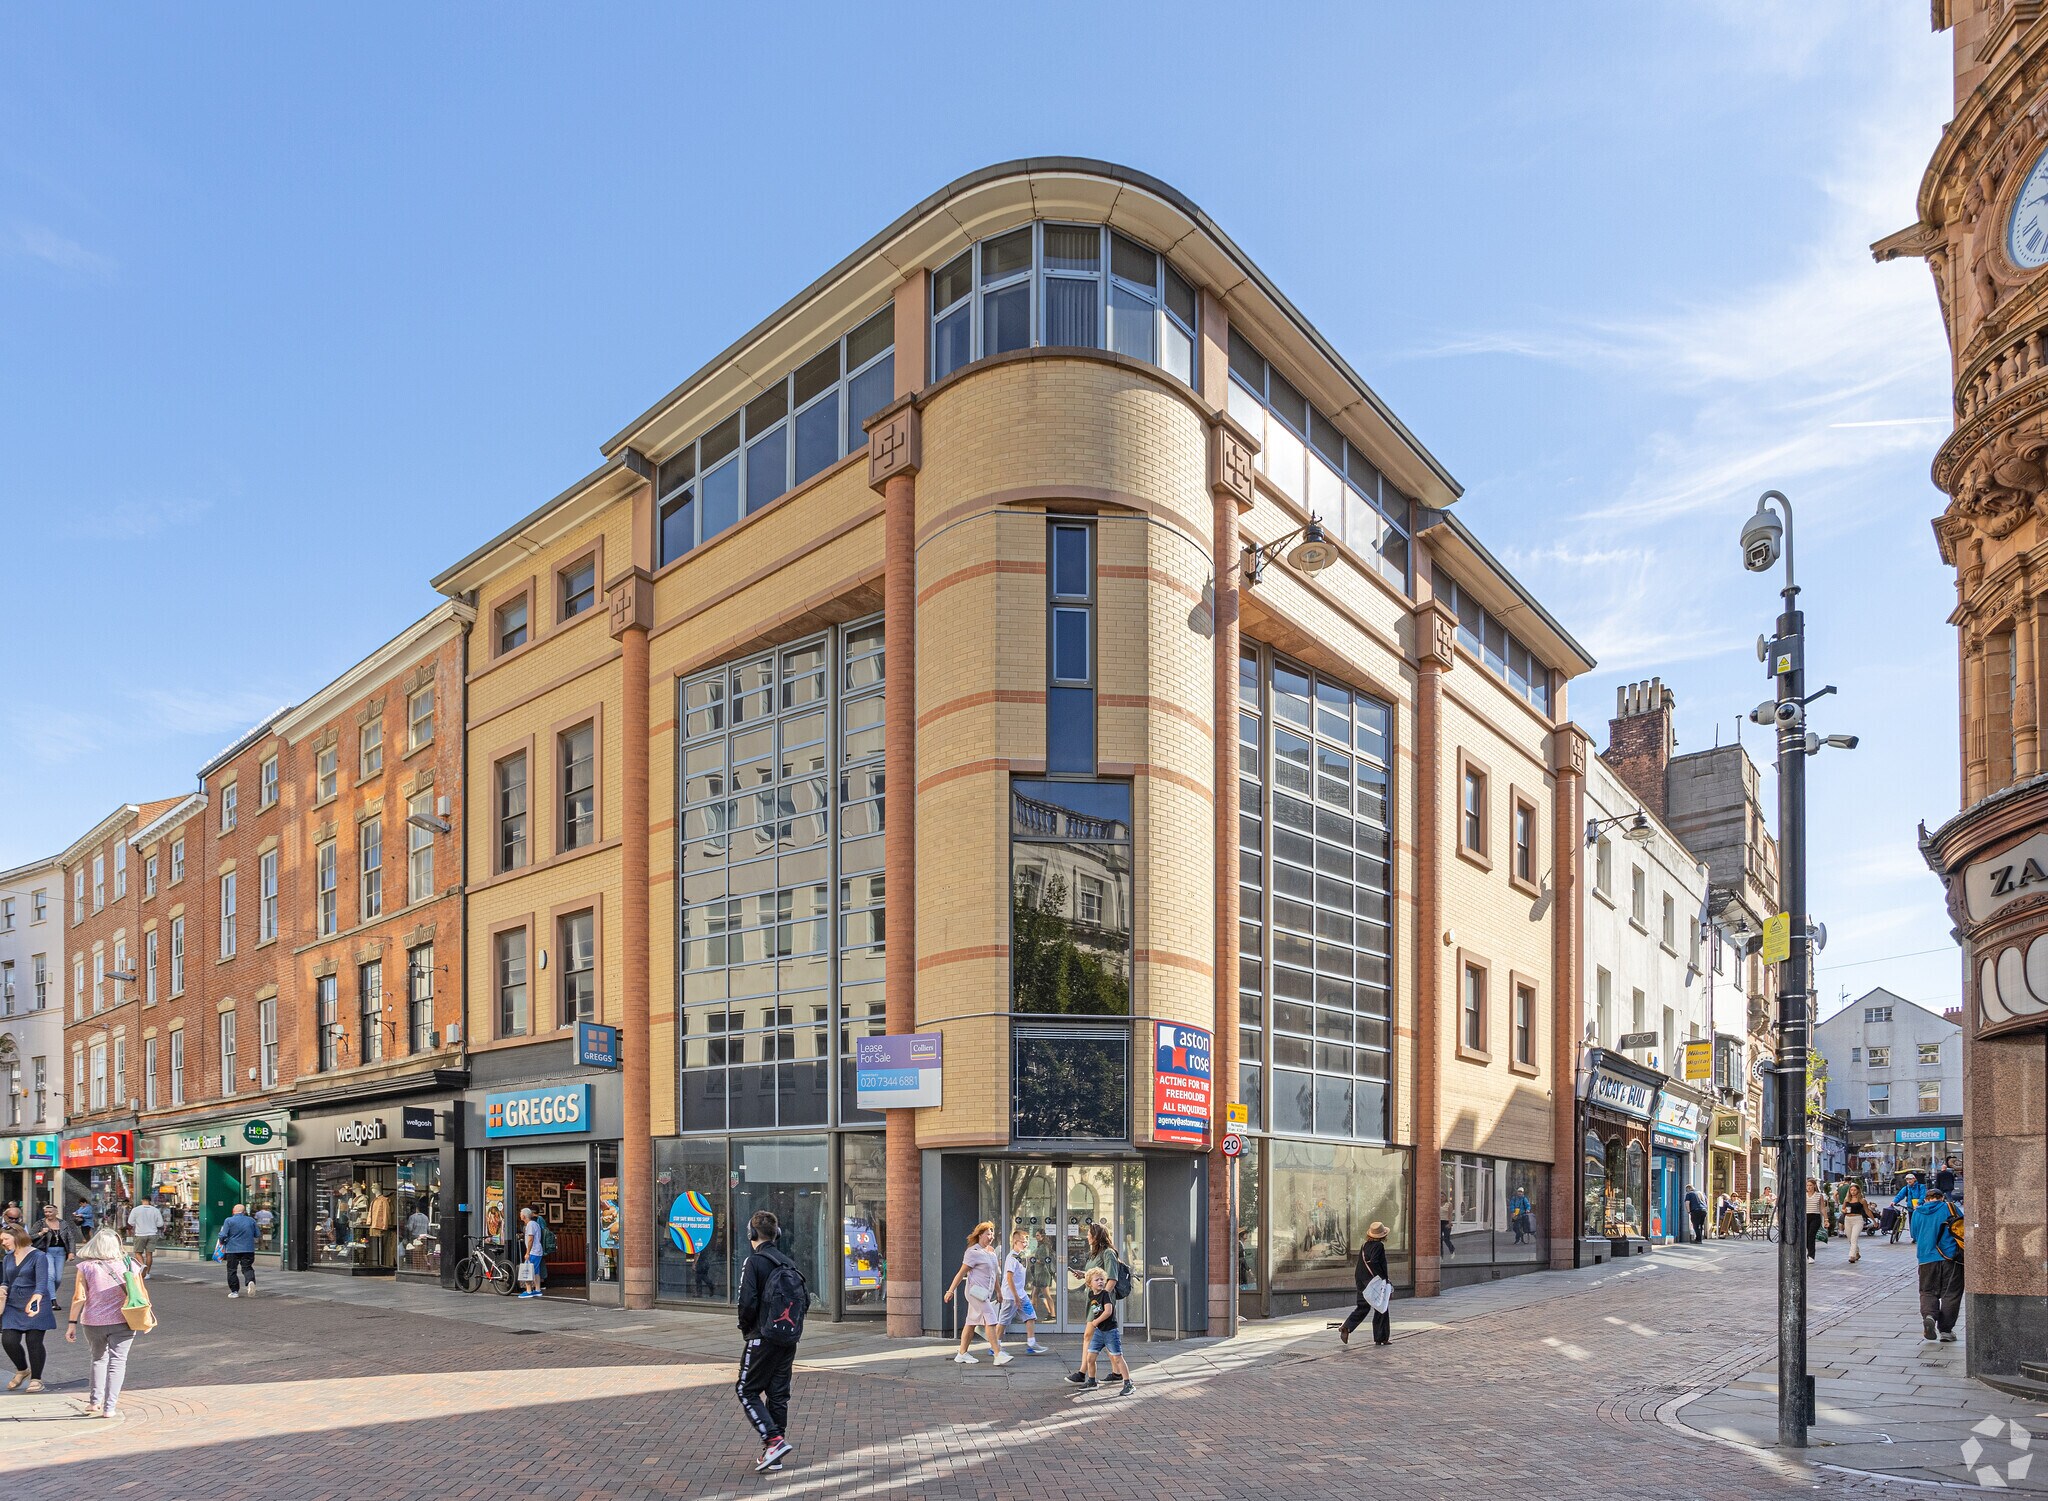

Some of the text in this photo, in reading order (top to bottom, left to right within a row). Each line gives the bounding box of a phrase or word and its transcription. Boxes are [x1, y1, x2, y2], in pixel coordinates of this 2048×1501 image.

[1990, 857, 2048, 897] ZA
[912, 1043, 934, 1052] Colliers
[1179, 1031, 1209, 1051] aston
[860, 1043, 883, 1053] Lease
[584, 1051, 613, 1063] GREGGS
[860, 1052, 891, 1063] For Sale
[1189, 1054, 1209, 1073] rose
[861, 1075, 918, 1088] 020 7344 6881
[1160, 1075, 1210, 1092] ACTING FOR THE
[1166, 1088, 1206, 1104] FREEHOLDER
[505, 1092, 580, 1127] GREGGS
[1162, 1101, 1208, 1116] ALL ENQUIRIES
[406, 1119, 432, 1127] wellgosh
[1720, 1119, 1737, 1128] FOX
[336, 1117, 380, 1147] wellgosh
[1901, 1130, 1940, 1138] Braderie
[1224, 1140, 1238, 1150] 20
